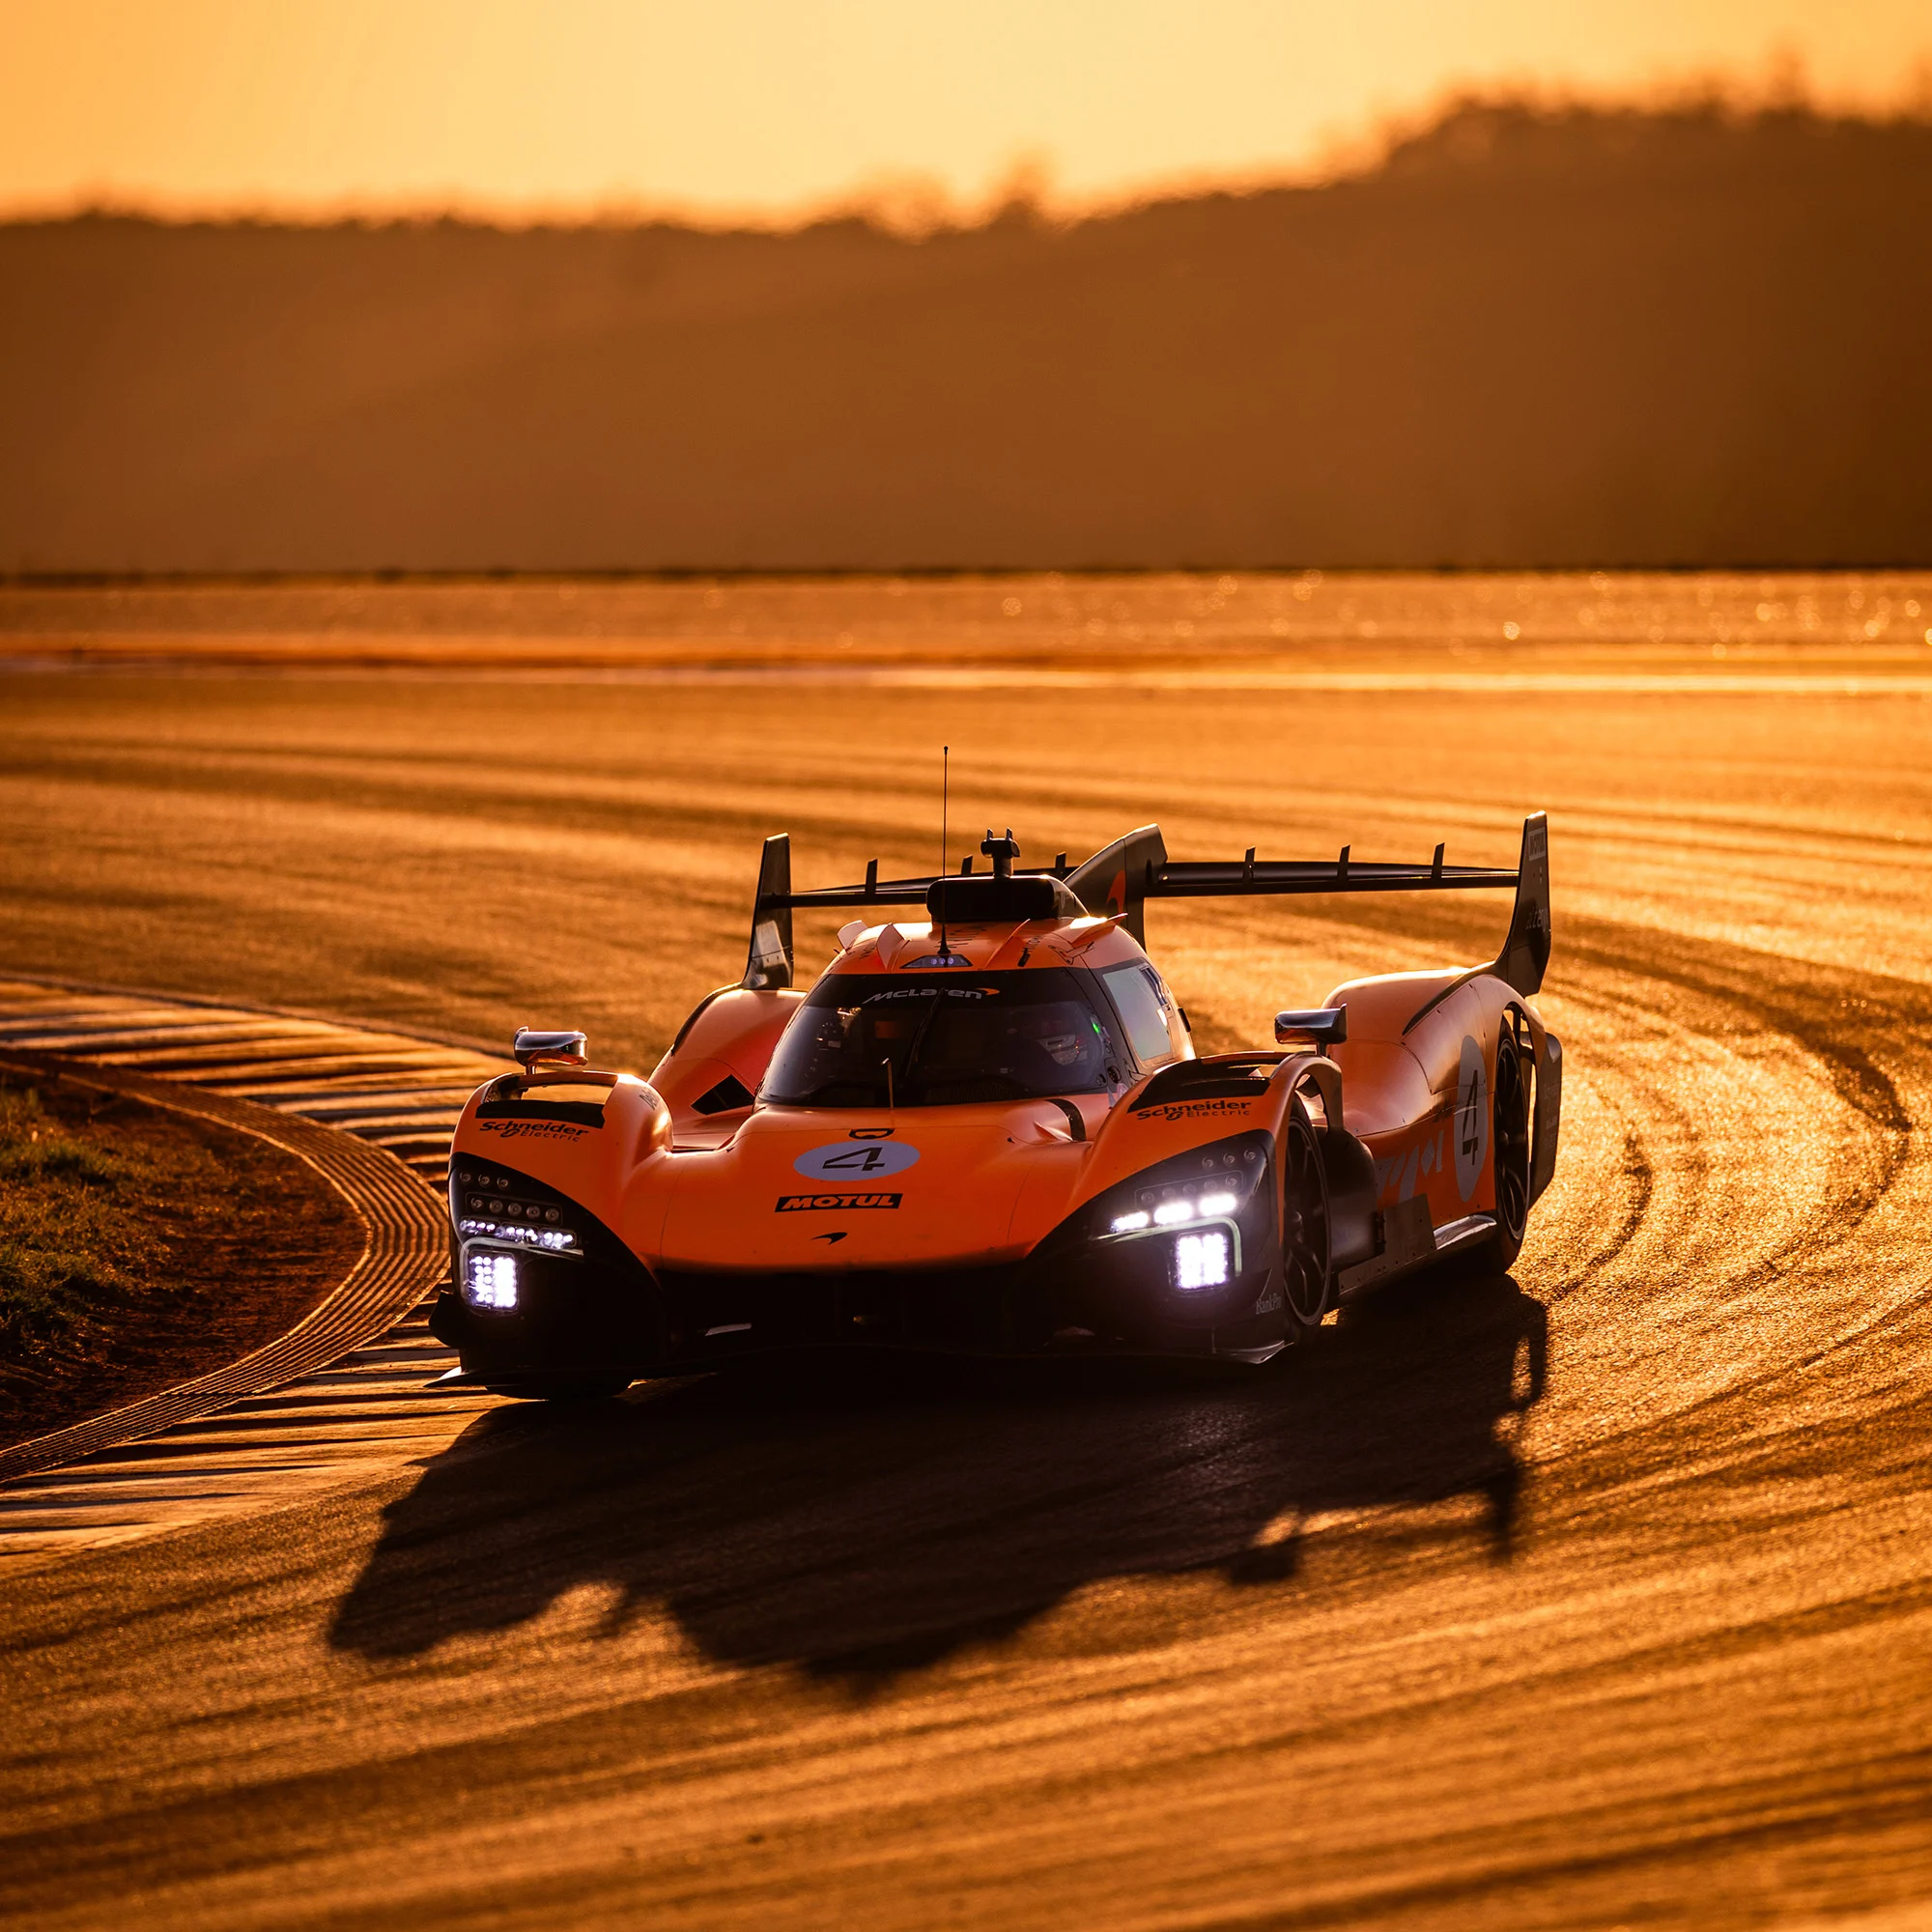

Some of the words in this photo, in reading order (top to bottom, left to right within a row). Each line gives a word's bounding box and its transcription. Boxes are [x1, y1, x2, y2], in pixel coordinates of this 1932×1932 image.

[1137, 1100, 1252, 1121] Schneider
[1462, 1069, 1479, 1166] 4
[479, 1121, 589, 1137] Schneider
[520, 1129, 581, 1142] Electric
[822, 1147, 885, 1171] 4
[781, 1195, 895, 1210] MOTUL
